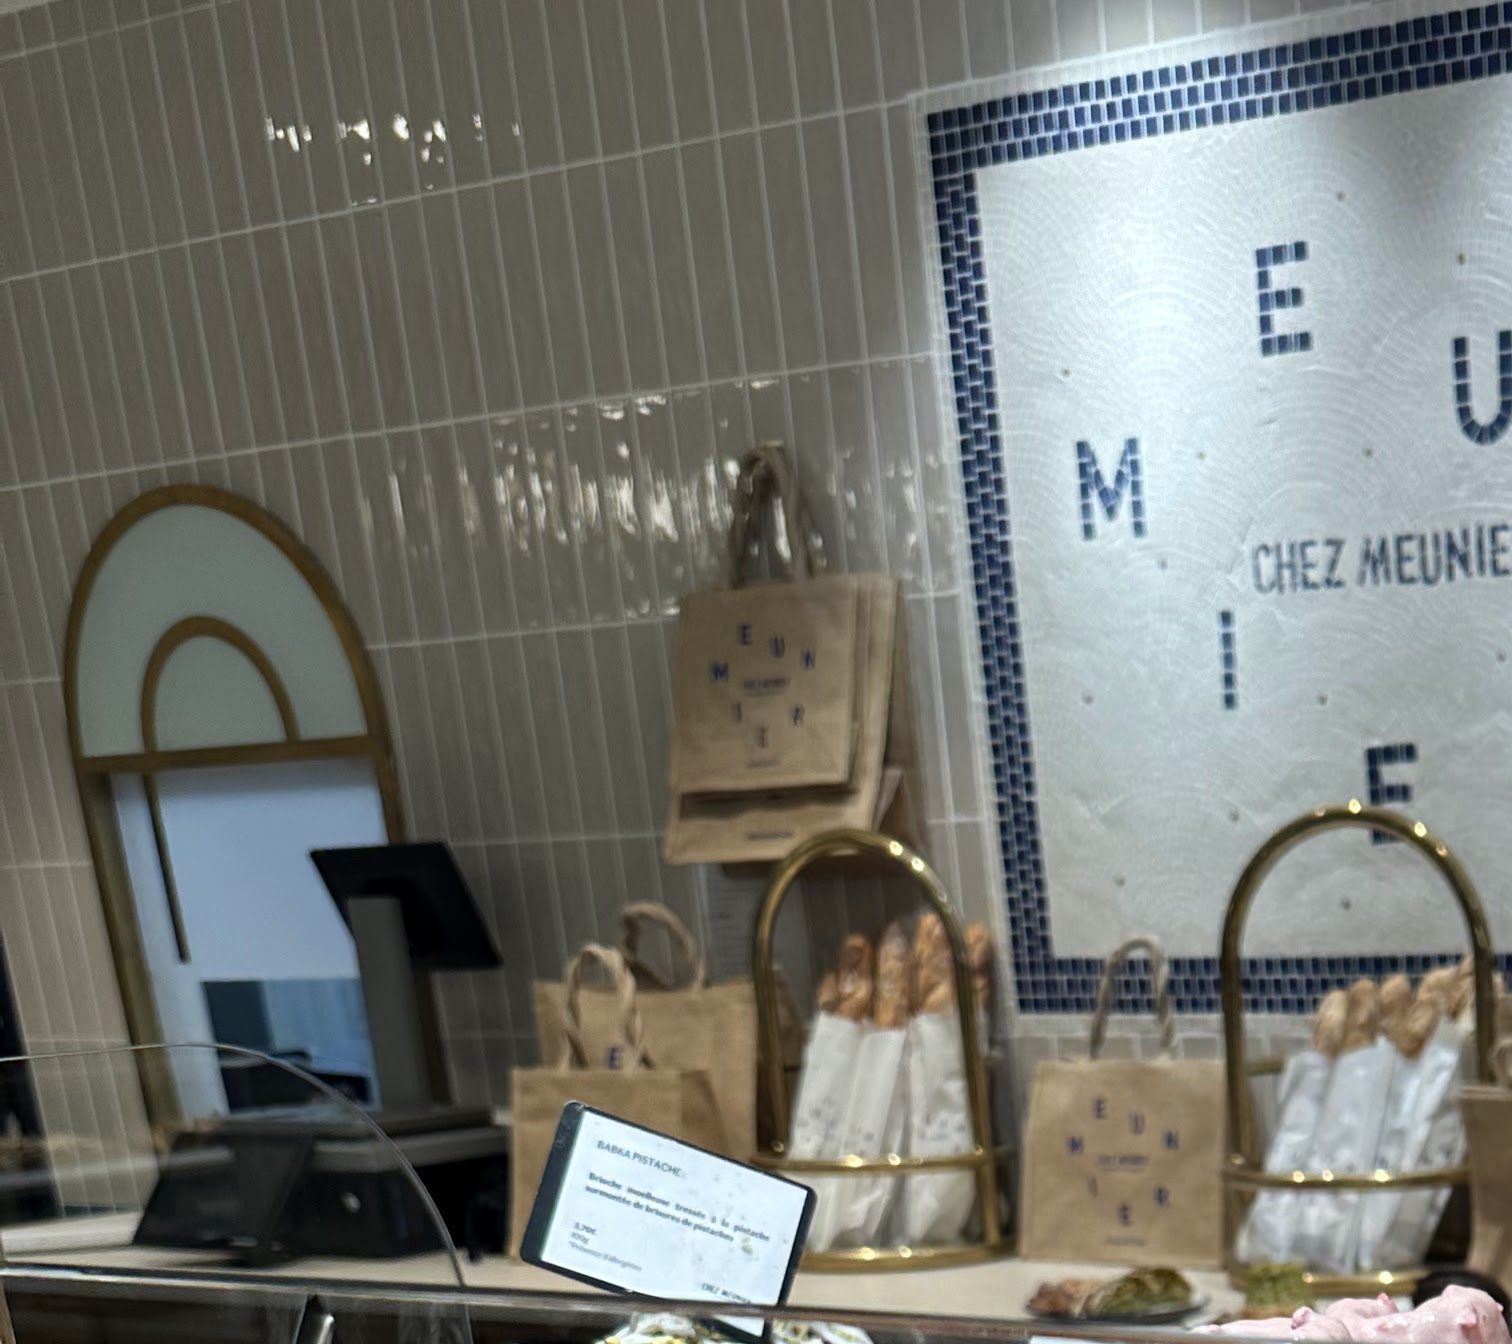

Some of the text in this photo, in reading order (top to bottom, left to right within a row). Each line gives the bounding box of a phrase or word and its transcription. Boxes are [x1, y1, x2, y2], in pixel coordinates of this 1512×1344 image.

[1075, 437, 1148, 540] M
[1256, 241, 1313, 356] E
[1252, 538, 1346, 595] CHEZ
[597, 1140, 632, 1160] BABKA
